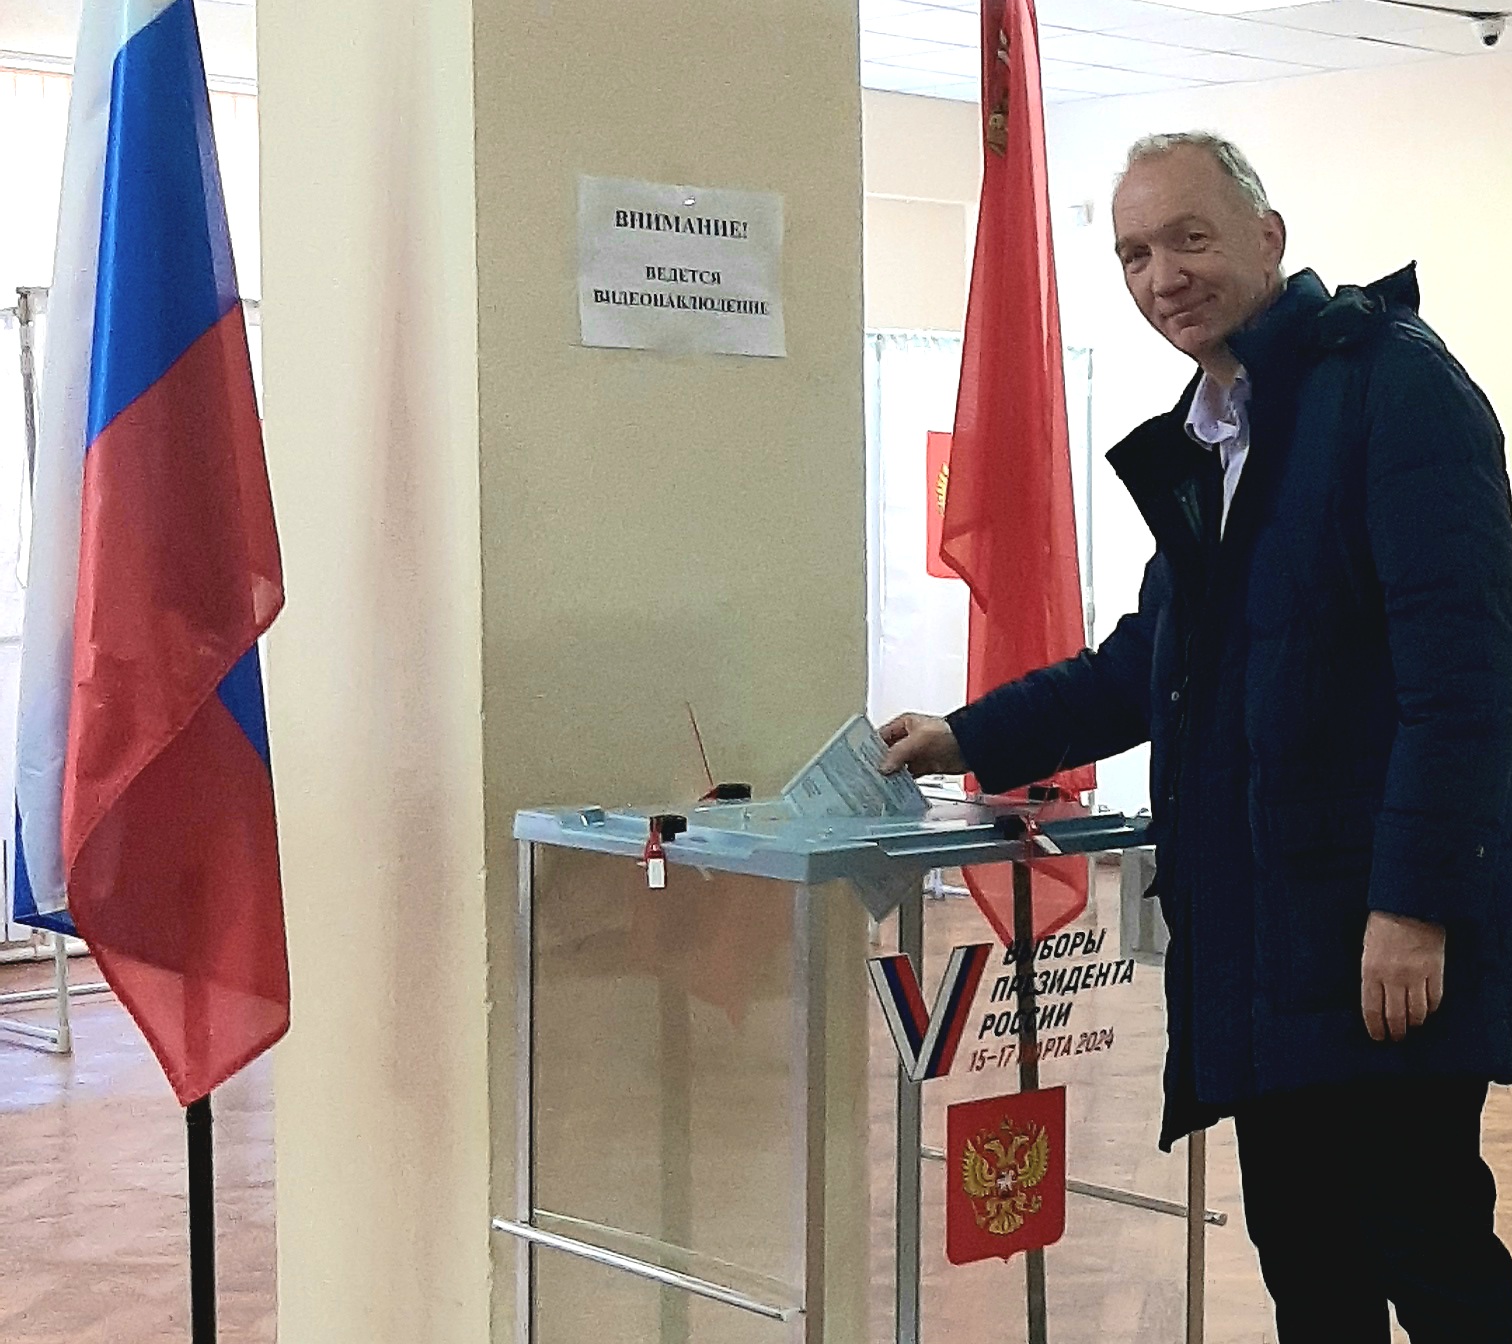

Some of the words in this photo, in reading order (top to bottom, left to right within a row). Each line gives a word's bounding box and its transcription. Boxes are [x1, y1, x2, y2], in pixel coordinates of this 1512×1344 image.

[614, 210, 748, 239] ВНИМАНИЕ!
[645, 265, 722, 285] ВЕДЕТСЯ
[990, 959, 1136, 1003] ПРЕЗИДЕНТА
[1017, 1034, 1073, 1064] АРТА
[1075, 1026, 1114, 1055] 2024
